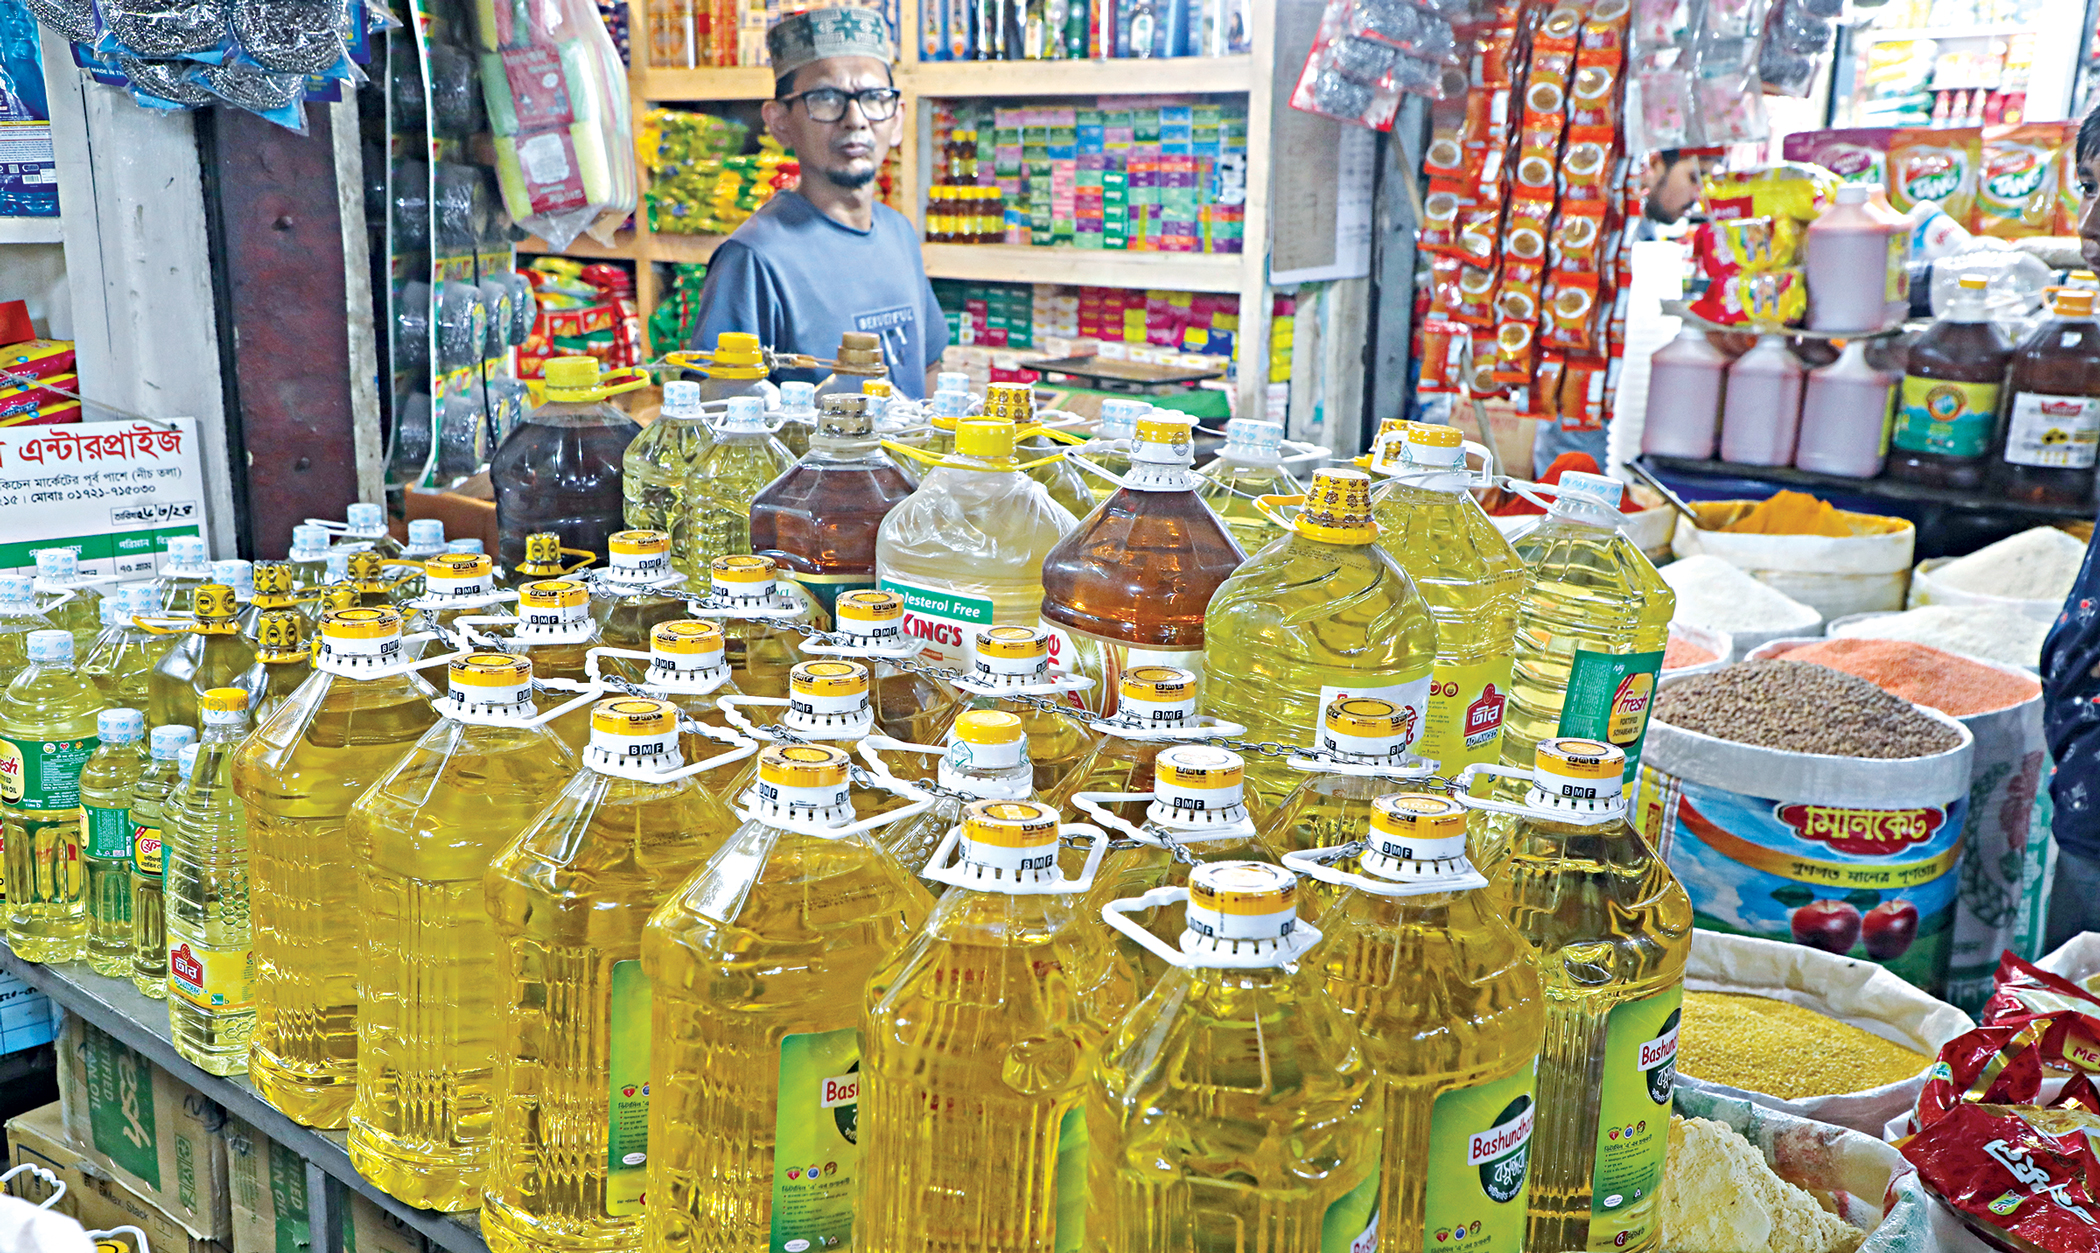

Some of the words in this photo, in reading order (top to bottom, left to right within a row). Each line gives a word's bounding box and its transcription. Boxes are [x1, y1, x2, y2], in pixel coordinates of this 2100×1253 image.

[19, 423, 183, 465] এন্টারপ্রাইজ
[455, 585, 479, 595] BMF
[953, 603, 981, 618] Free
[532, 615, 558, 624] BMF
[874, 627, 897, 636] BMF
[1617, 690, 1649, 714] Fresh
[1154, 711, 1182, 720] BMF
[1472, 704, 1500, 727] তীর
[630, 743, 662, 755] BMF
[1563, 786, 1595, 798] BMF
[1175, 798, 1203, 809] BMF
[1383, 842, 1412, 858] BMF
[1022, 855, 1052, 869] BMF
[175, 956, 198, 980] তীর
[126, 1201, 149, 1220] Stack
